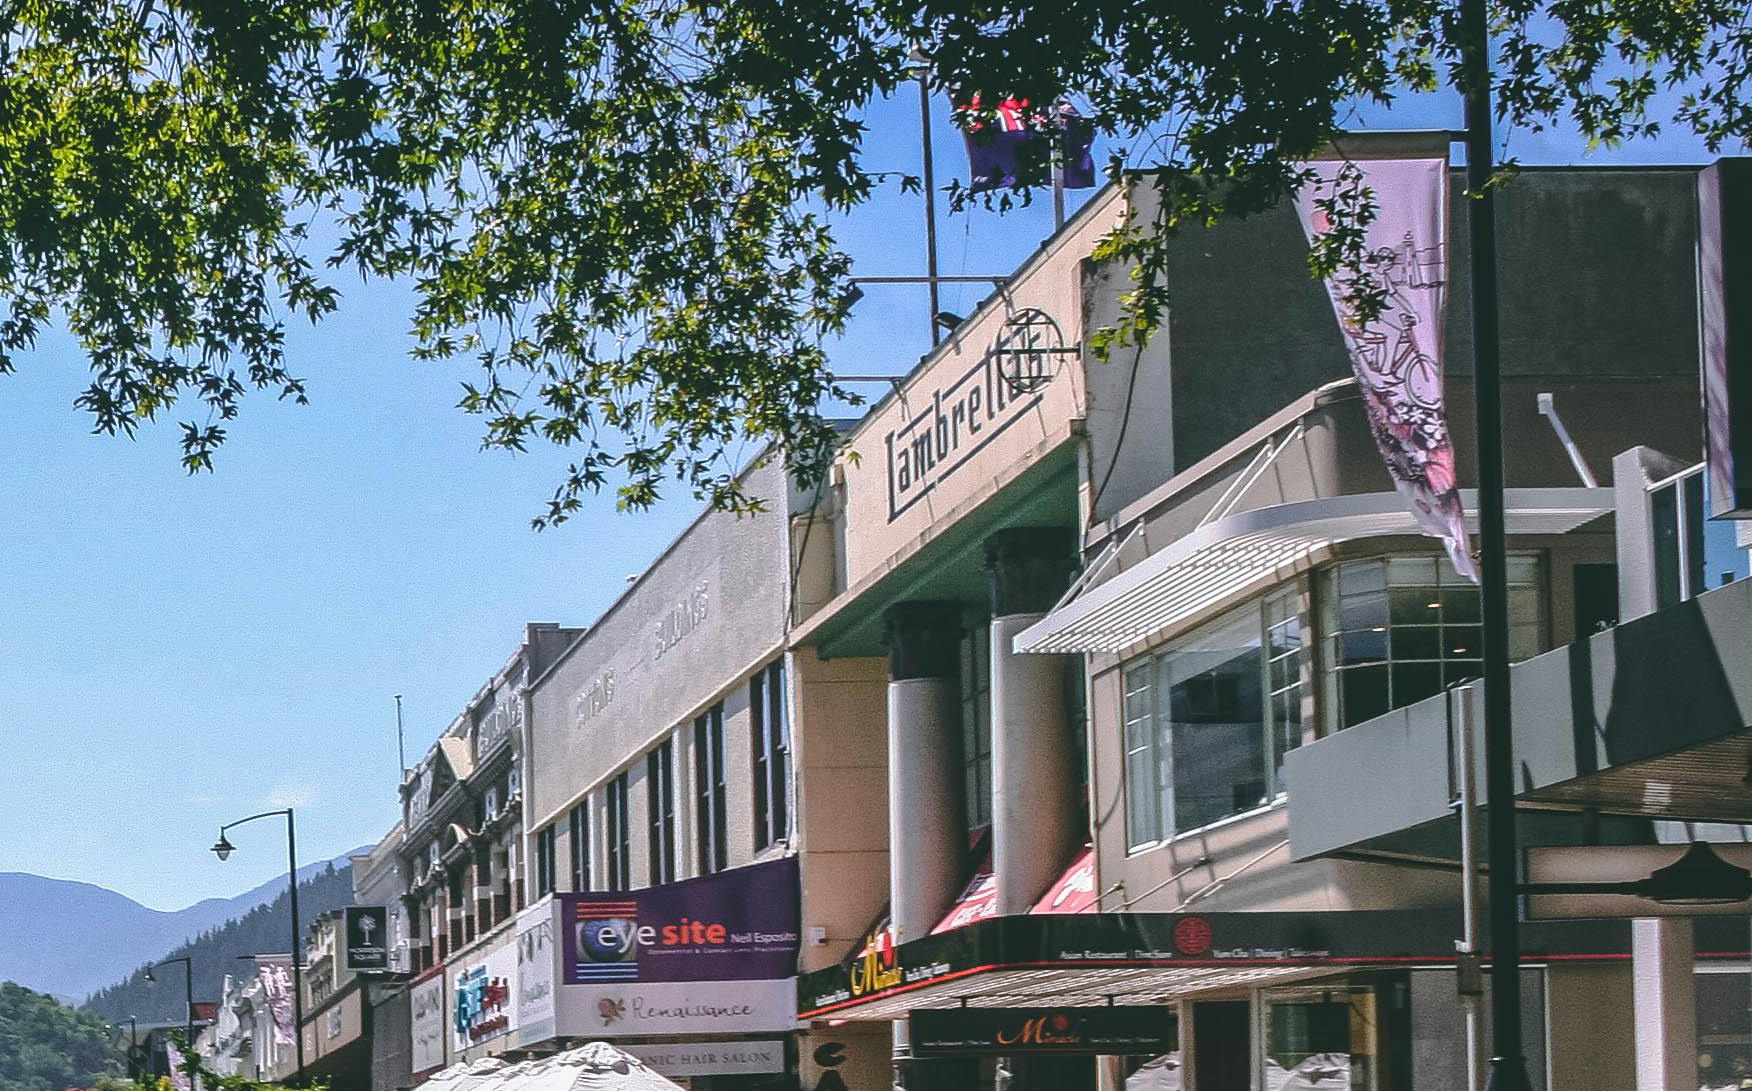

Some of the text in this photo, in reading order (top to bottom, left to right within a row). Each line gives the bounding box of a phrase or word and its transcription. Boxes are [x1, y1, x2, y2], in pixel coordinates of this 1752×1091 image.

[597, 925, 657, 953] eye
[661, 918, 727, 945] site
[632, 996, 753, 1020] Renaissance
[680, 1053, 718, 1065] HAIR
[722, 1050, 771, 1064] SALON
